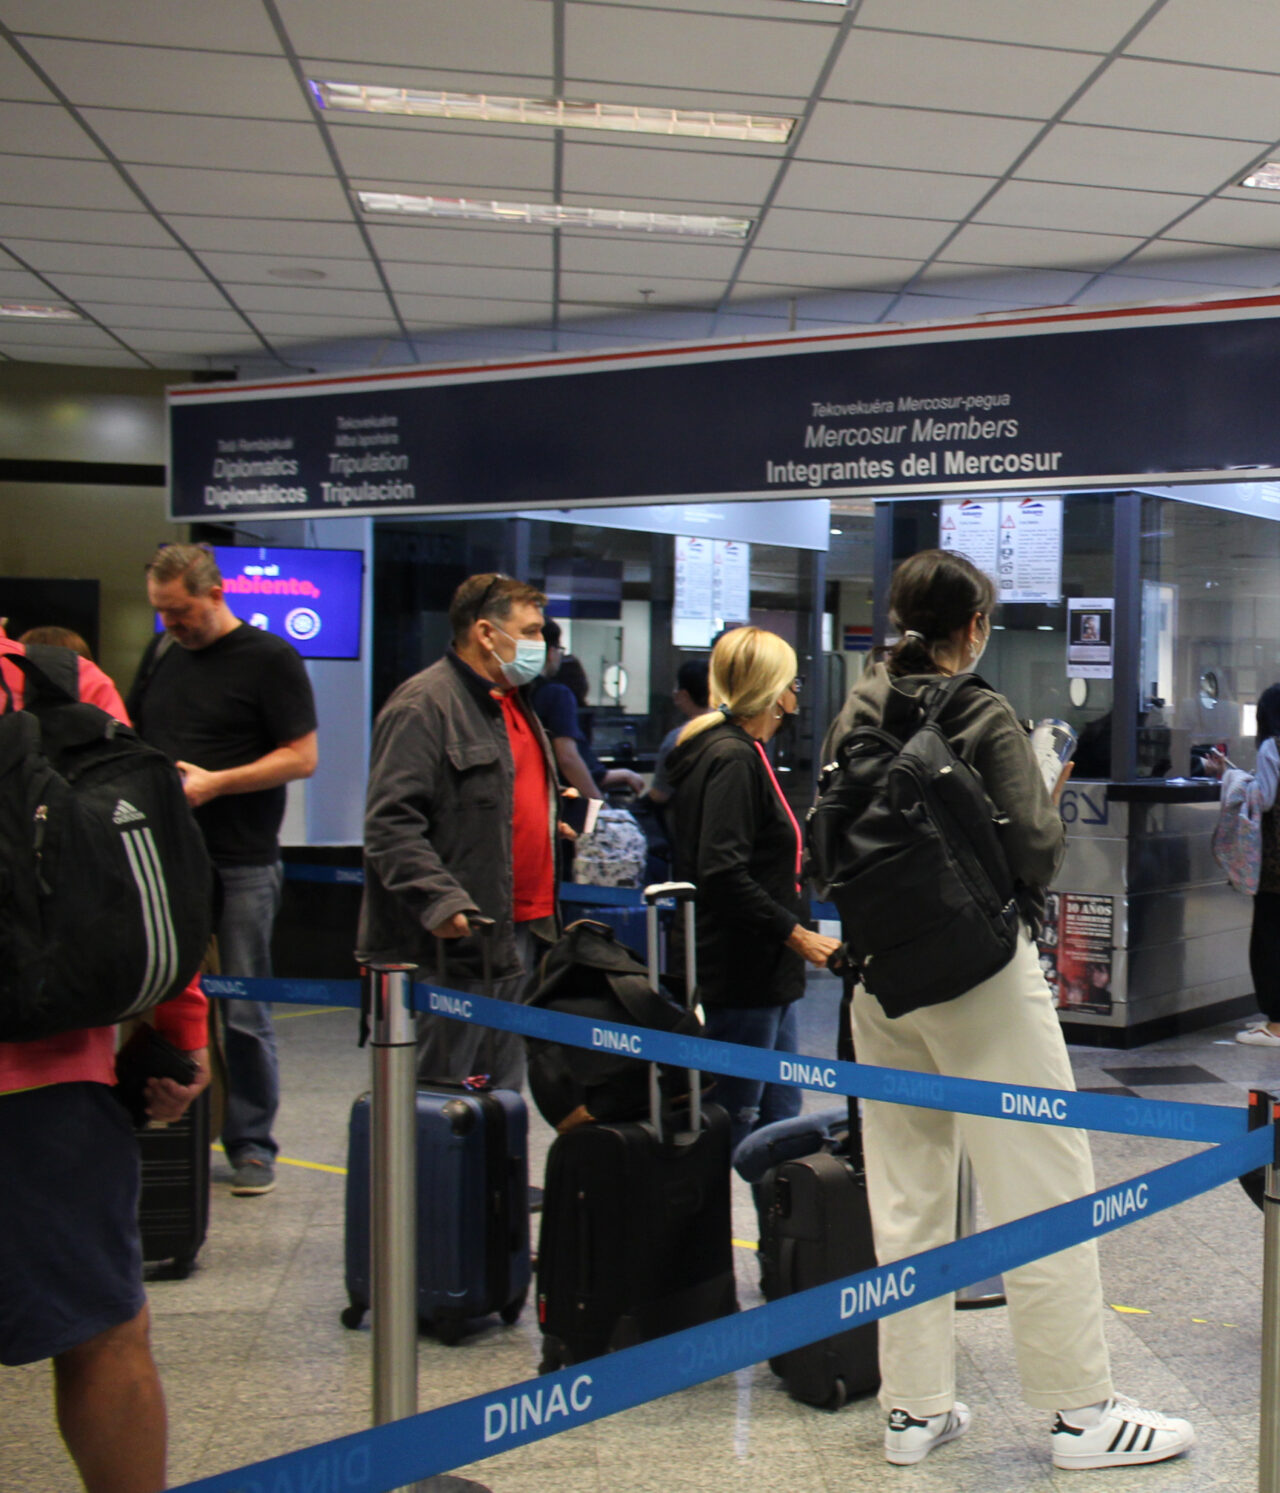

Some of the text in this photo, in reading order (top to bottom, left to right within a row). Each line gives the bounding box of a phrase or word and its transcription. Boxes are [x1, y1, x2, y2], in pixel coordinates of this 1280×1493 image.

[811, 397, 894, 417] Tekovekuéra
[804, 415, 1019, 448] Mercosur Members
[213, 456, 298, 481] Diplomatics
[328, 452, 409, 478] Tripulation
[766, 450, 1062, 486] Integrantes del Mercosur
[204, 483, 308, 510] Diplomáticos
[320, 478, 415, 506] Tripulación
[222, 575, 320, 599] mbiente,
[1060, 790, 1079, 823] 6
[203, 979, 247, 995] DINAC
[429, 992, 472, 1018] DINAC
[592, 1027, 642, 1054] DINAC
[779, 1061, 837, 1088] DINAC
[1001, 1092, 1067, 1120] DINAC
[1092, 1183, 1148, 1227] DINAC
[840, 1266, 916, 1319] DINAC
[484, 1375, 593, 1443] DINAC
